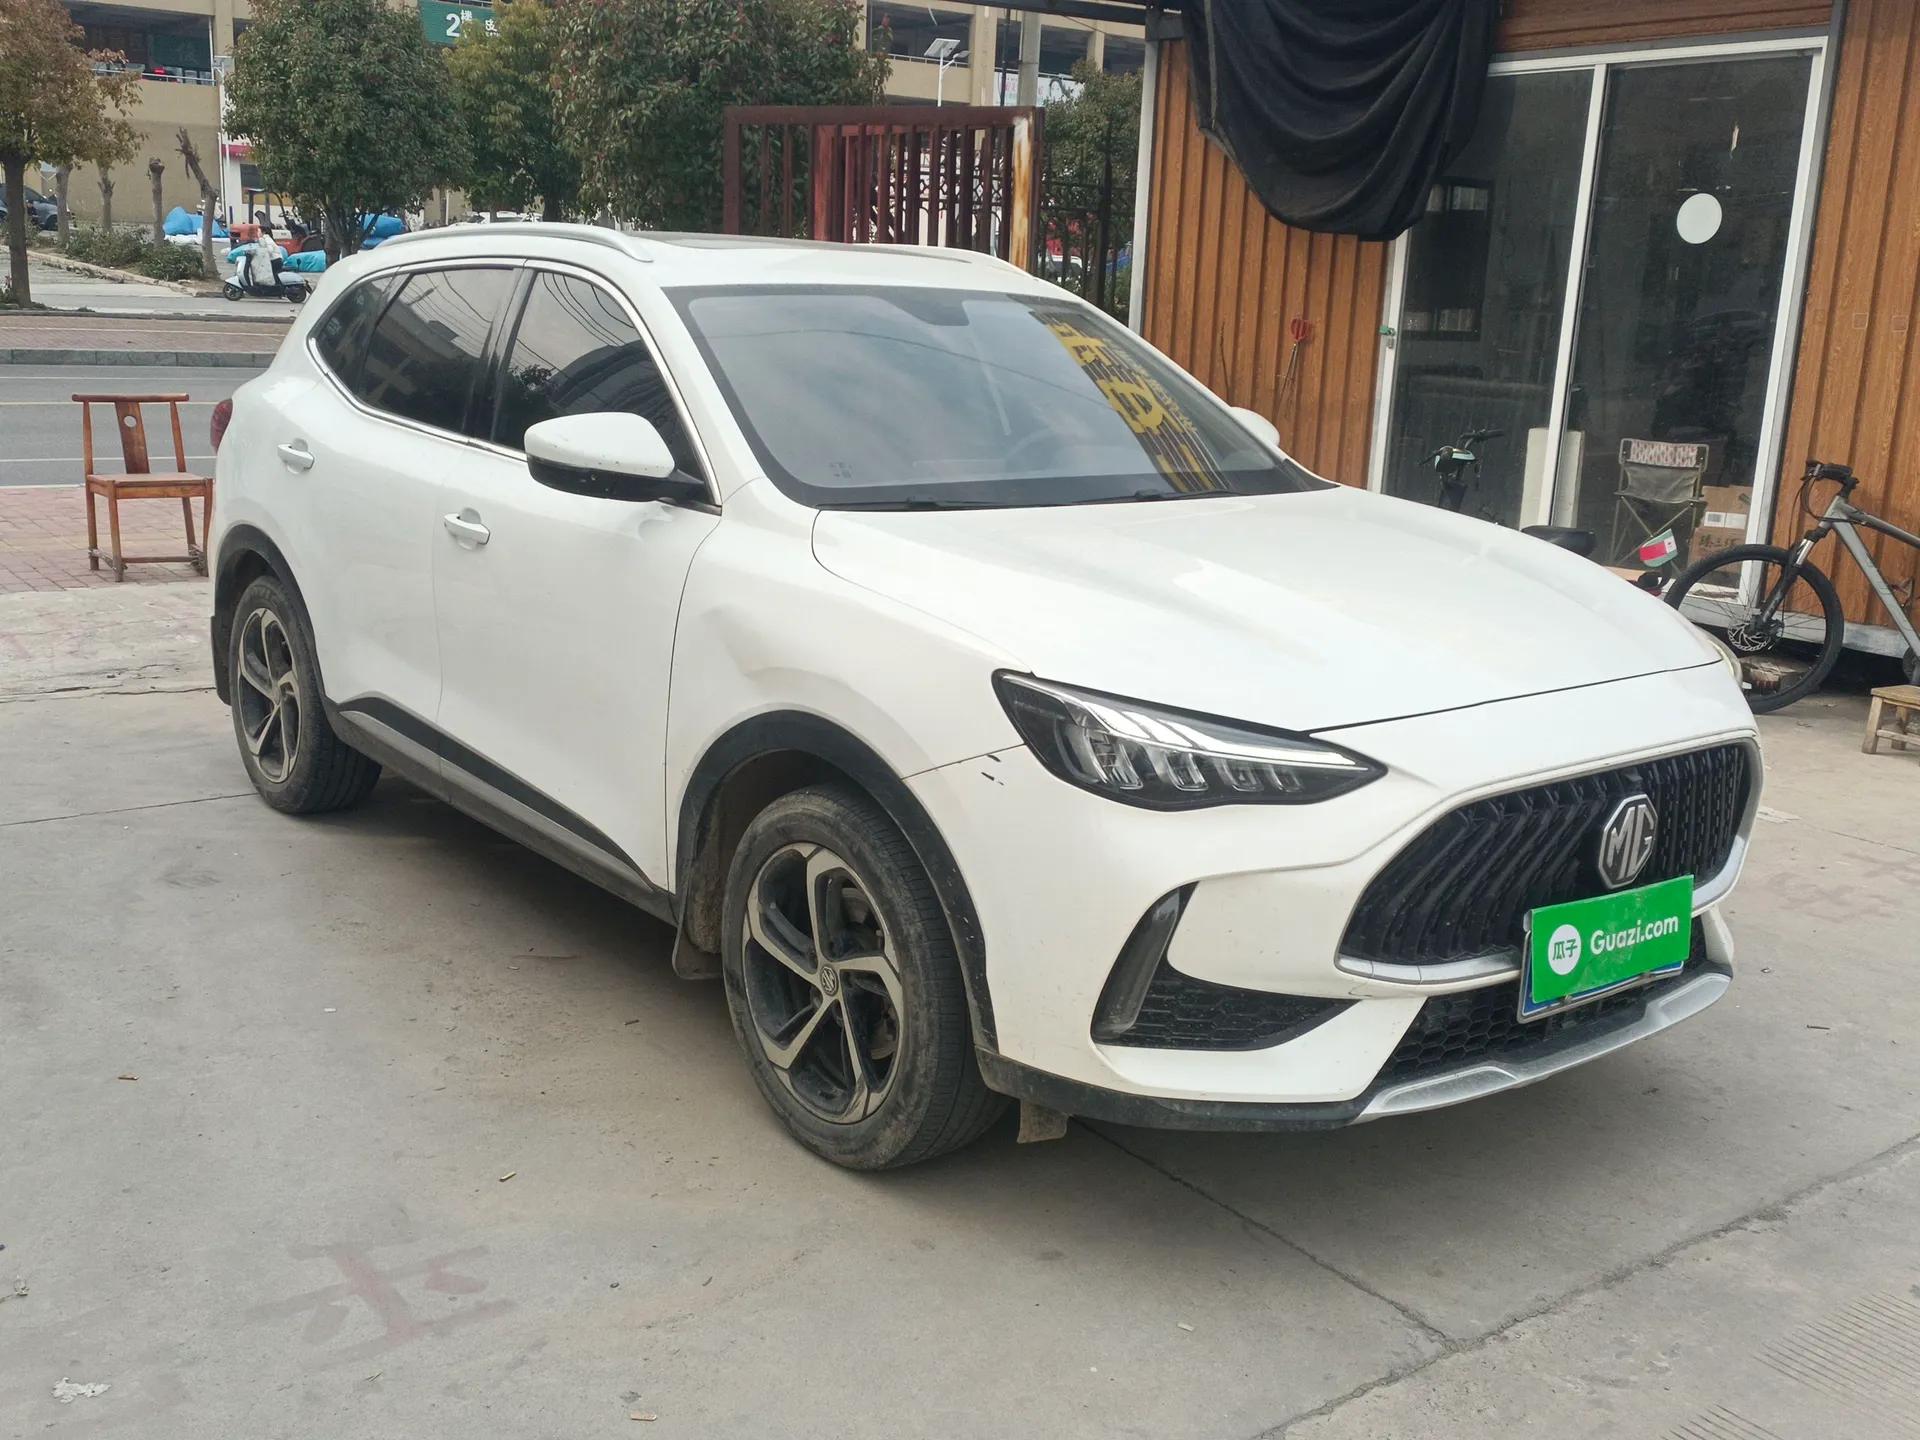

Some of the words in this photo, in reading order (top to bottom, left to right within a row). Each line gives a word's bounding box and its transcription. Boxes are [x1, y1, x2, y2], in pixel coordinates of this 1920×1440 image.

[1606, 804, 1655, 880] MG
[1552, 938, 1578, 961] 瓜子
[1590, 916, 1679, 955] Guazi.com
